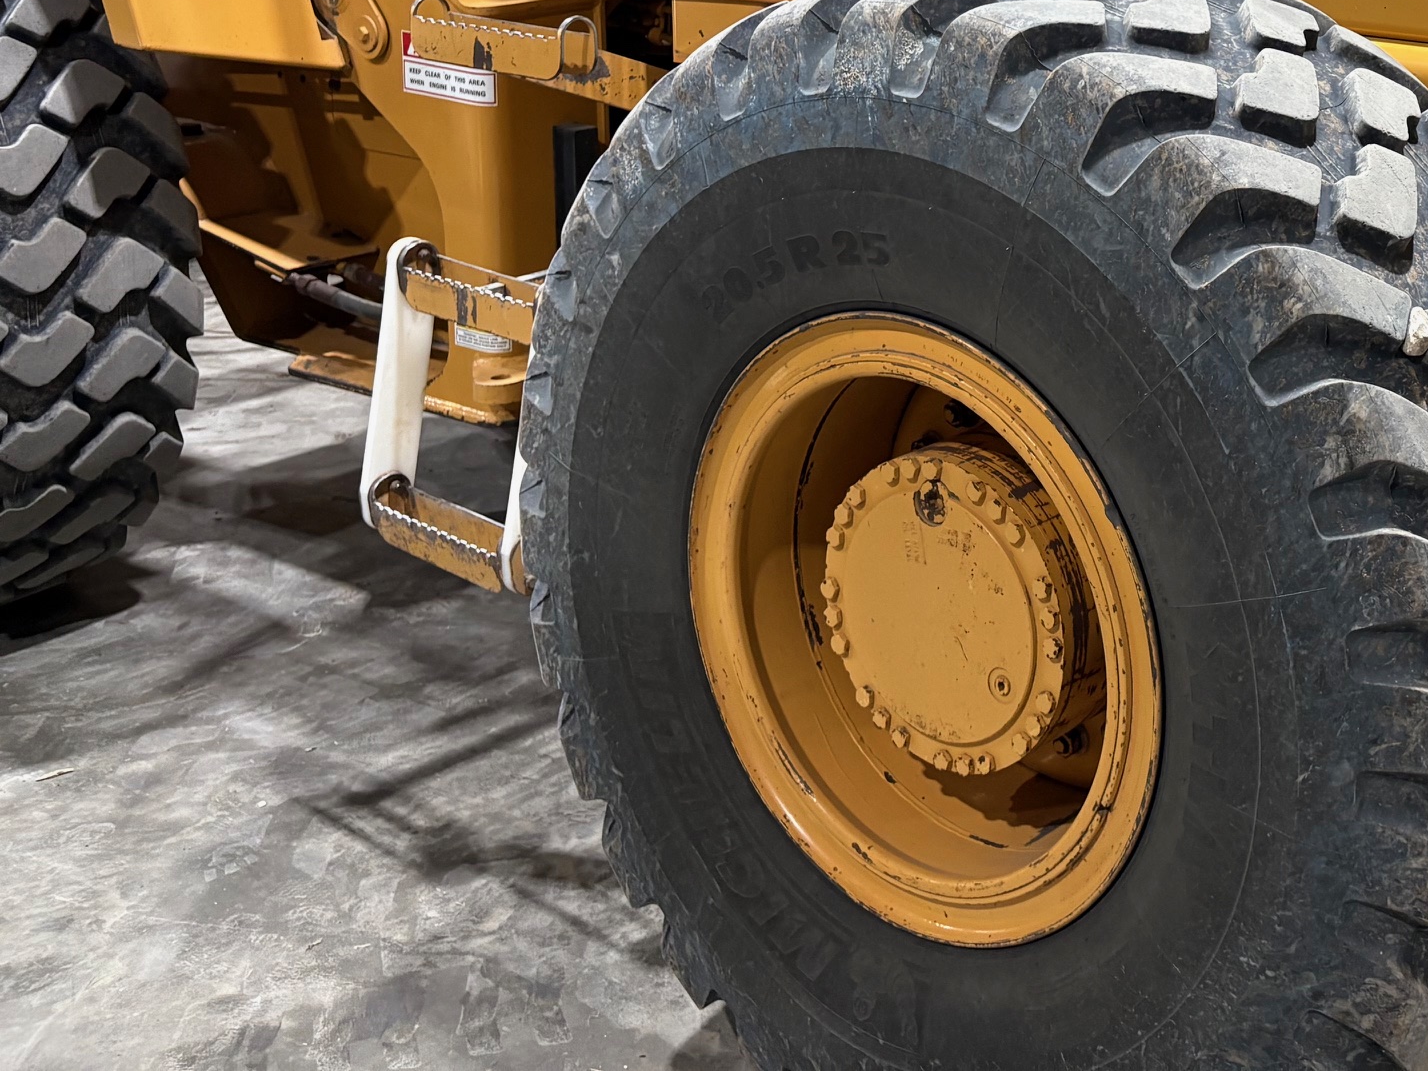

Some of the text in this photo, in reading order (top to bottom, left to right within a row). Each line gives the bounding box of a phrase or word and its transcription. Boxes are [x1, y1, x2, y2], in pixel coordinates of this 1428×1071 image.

[410, 78, 424, 86] WHEN
[429, 81, 447, 90] ENGINE
[459, 87, 486, 97] RUNNING
[425, 70, 440, 78] CLEAR
[455, 76, 466, 84] THIS
[469, 79, 486, 87] AREA
[701, 230, 890, 325] 20.5 R 25
